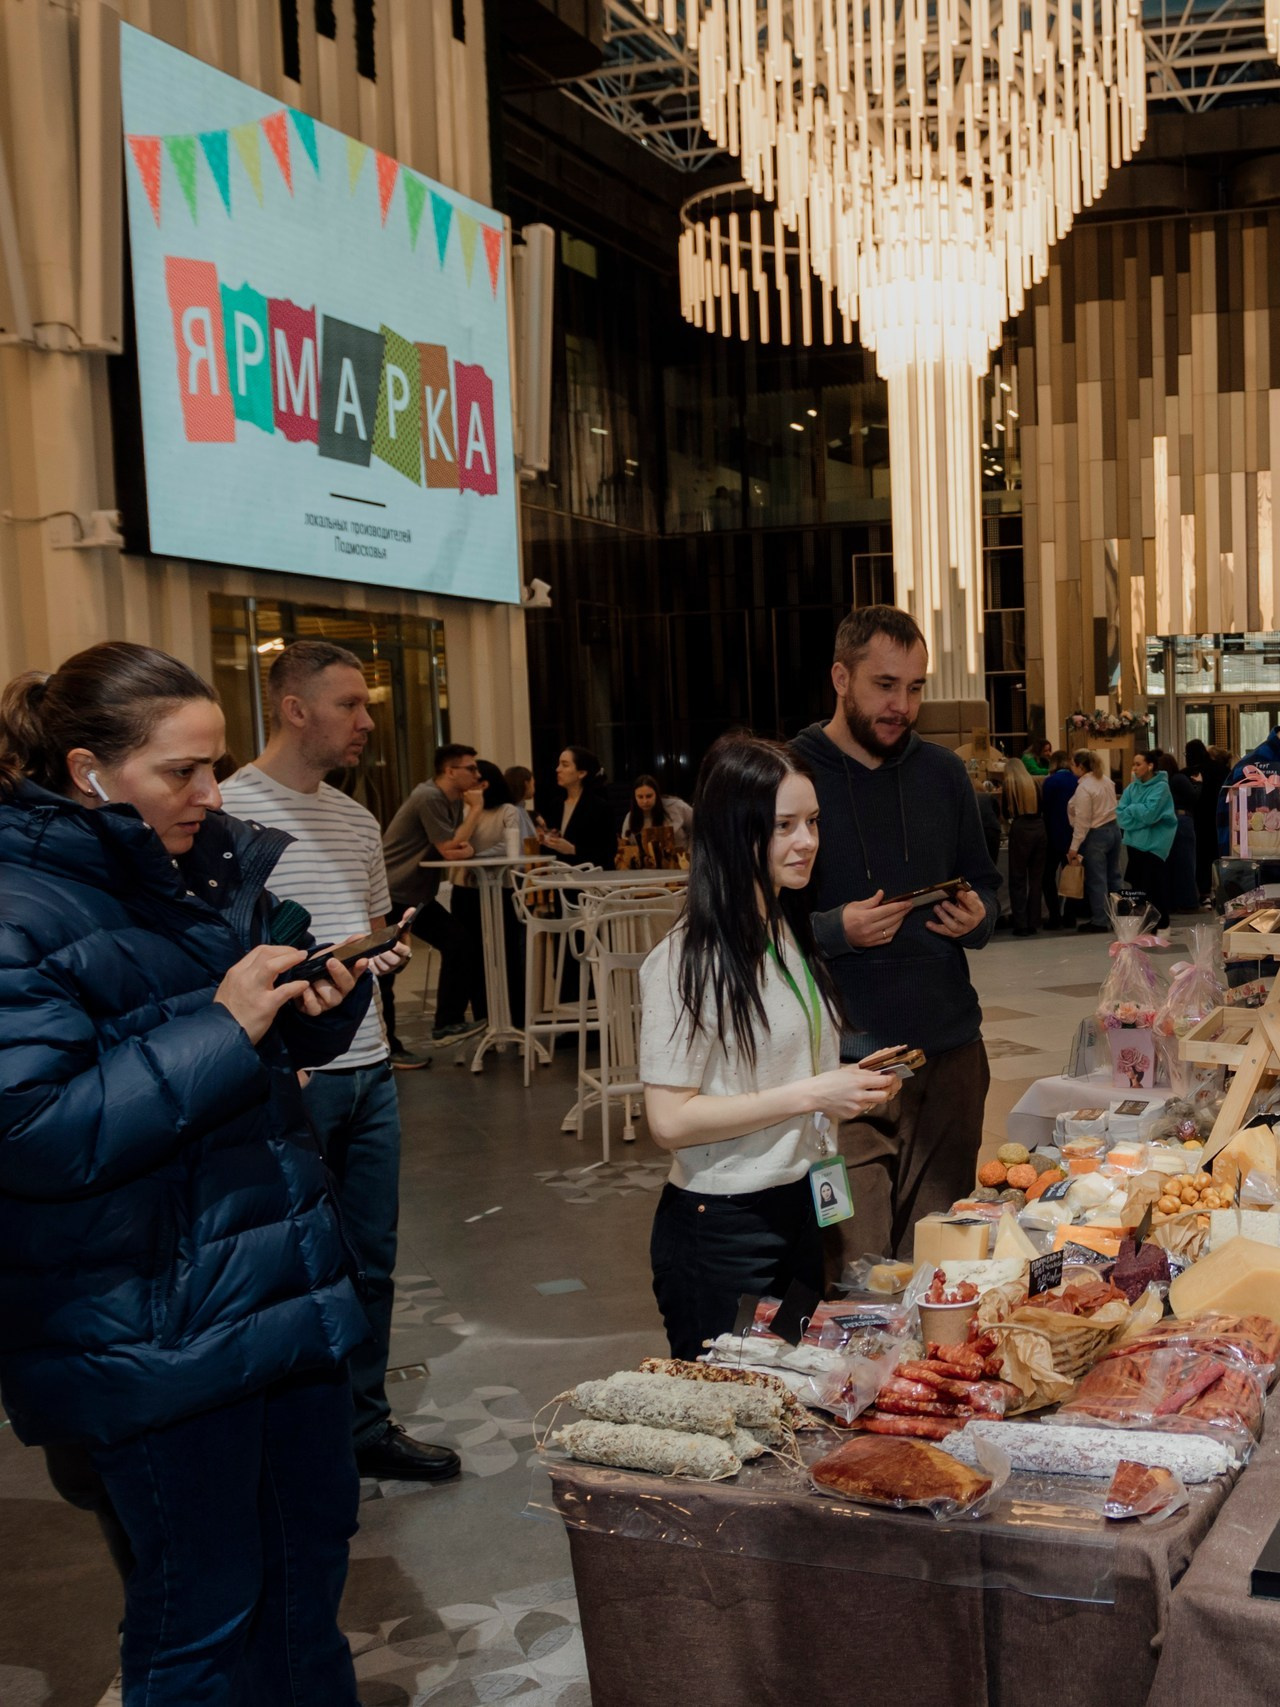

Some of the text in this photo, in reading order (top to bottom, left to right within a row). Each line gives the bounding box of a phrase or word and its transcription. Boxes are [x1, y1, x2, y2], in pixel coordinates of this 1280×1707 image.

[181, 306, 492, 475] ЯРМАРКА
[304, 512, 412, 543] локальных производителей
[334, 536, 387, 559] Подмосковья
